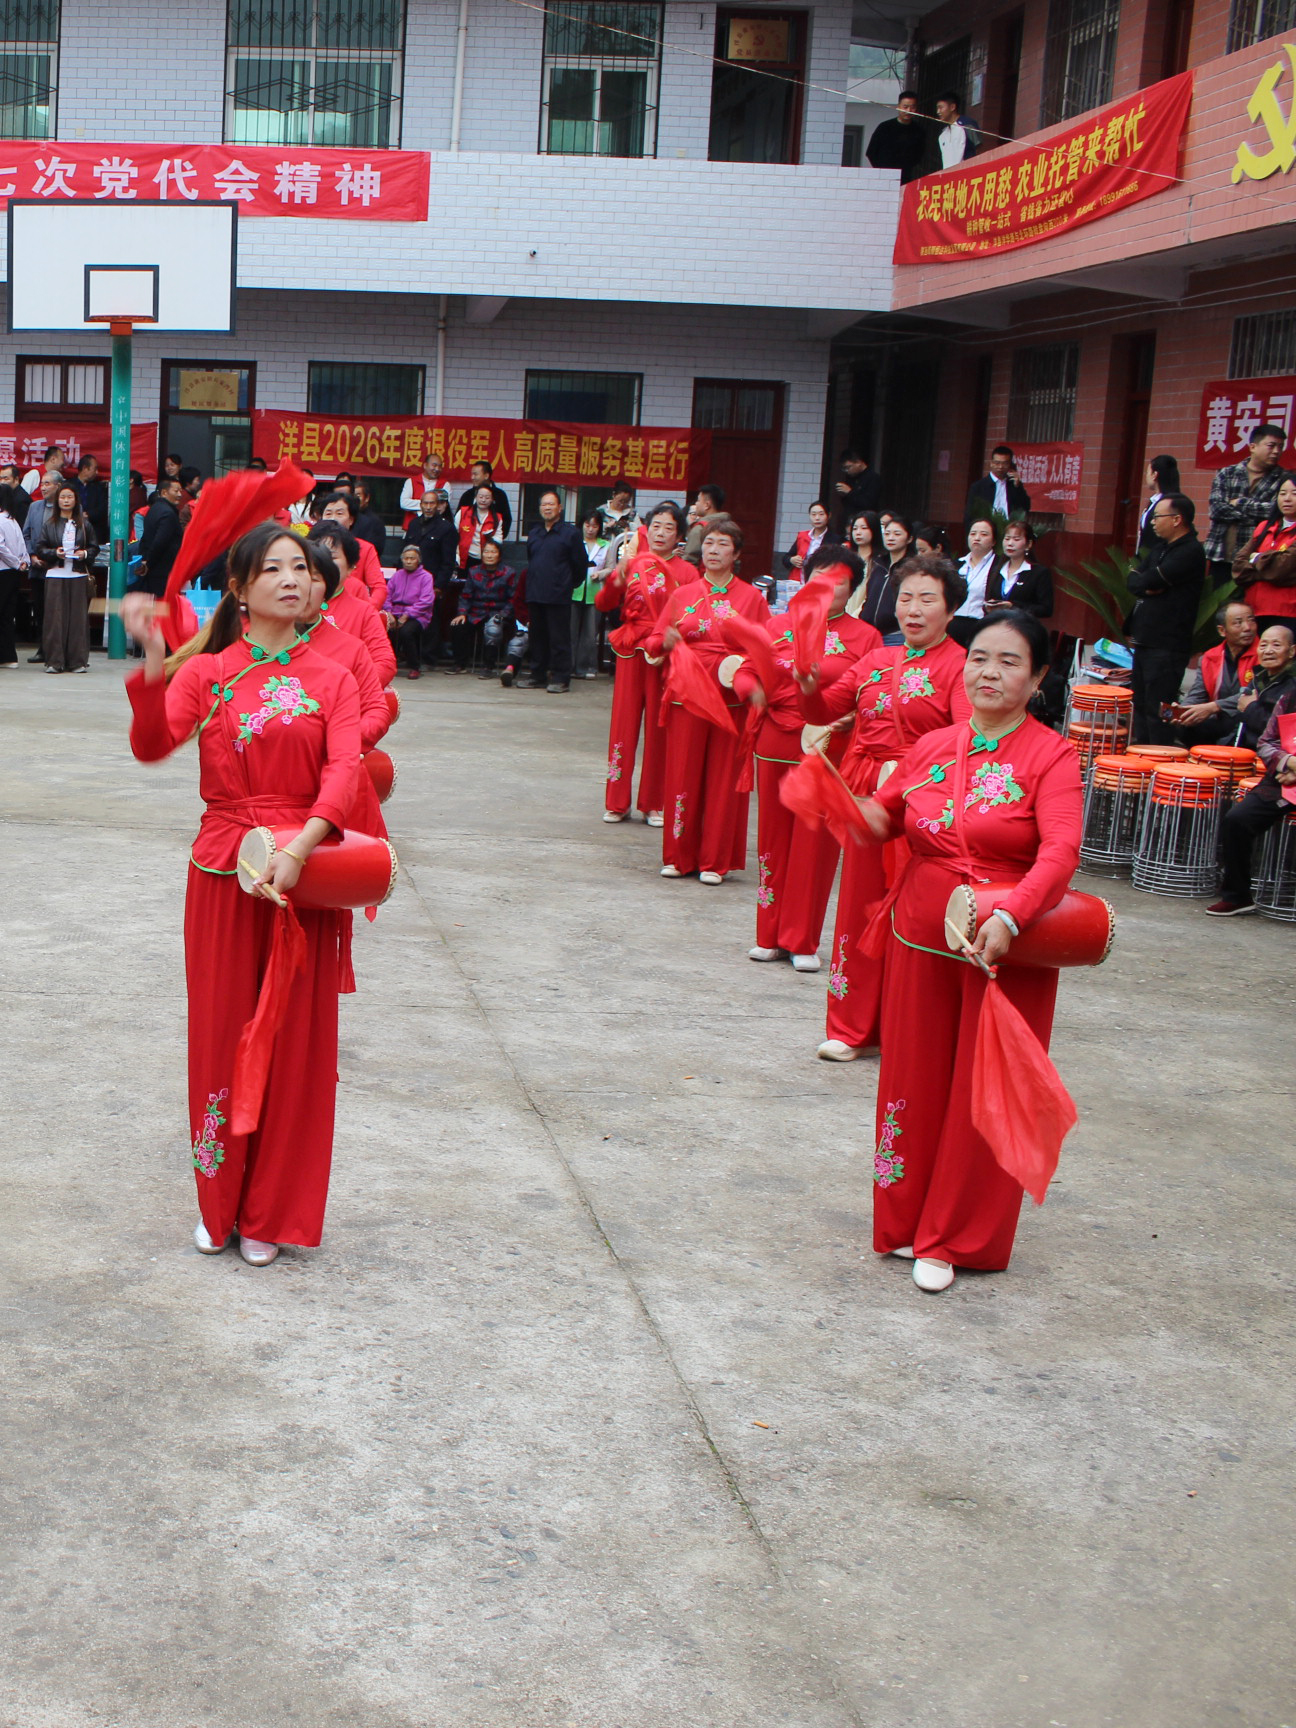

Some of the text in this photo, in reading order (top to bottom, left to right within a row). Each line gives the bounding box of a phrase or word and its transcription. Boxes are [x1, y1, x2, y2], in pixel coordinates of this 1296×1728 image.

[916, 102, 1146, 223] 农民种地不用愁 农业托管来帮忙
[277, 420, 689, 480] 洋县2026年度退役军人高质量服务基层行
[1203, 394, 1296, 453] 黄安司
